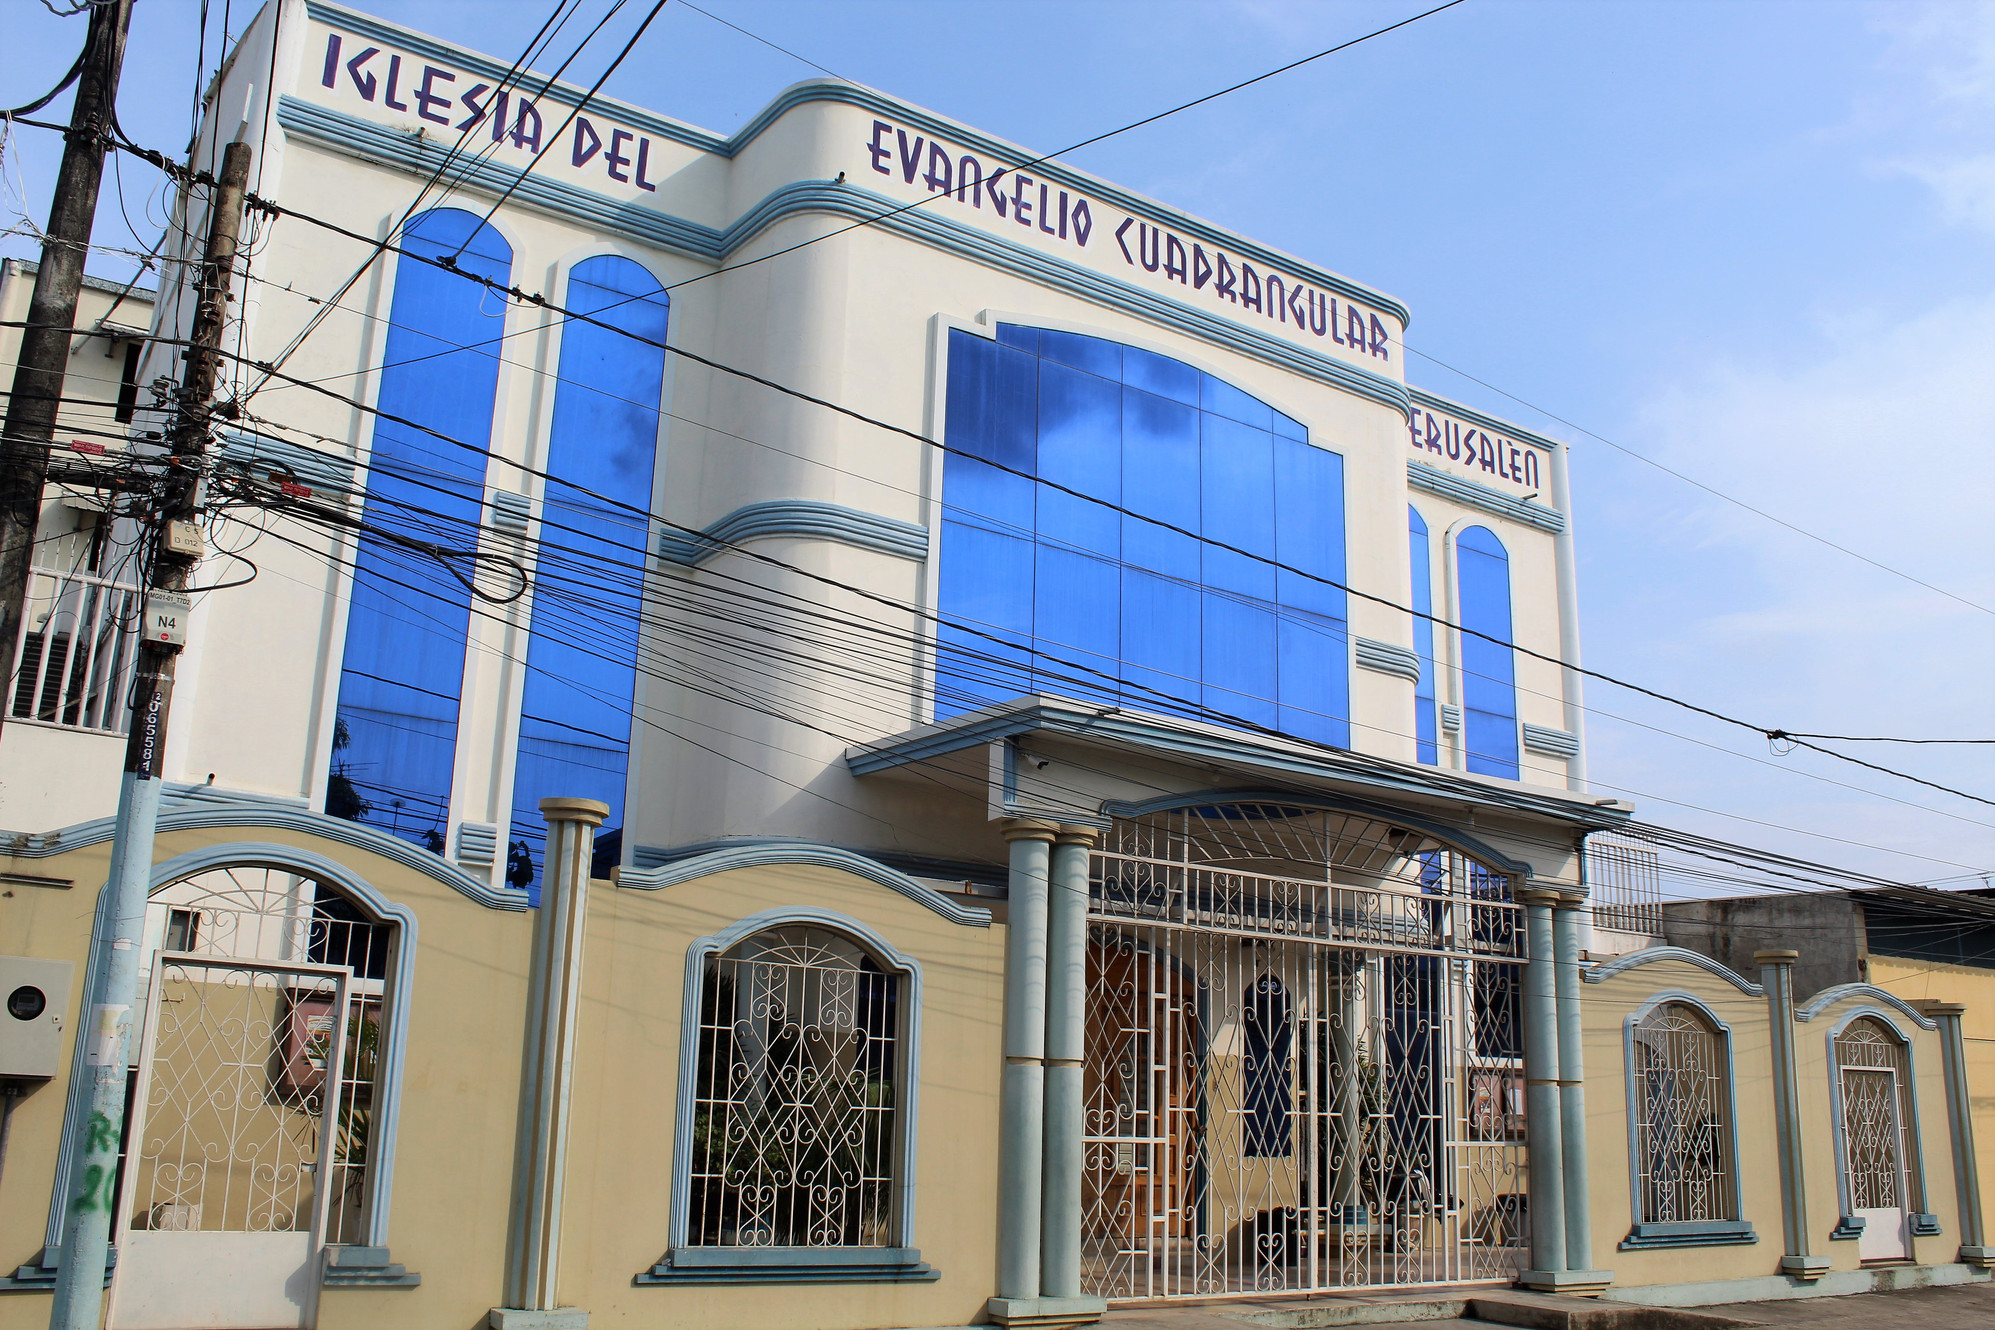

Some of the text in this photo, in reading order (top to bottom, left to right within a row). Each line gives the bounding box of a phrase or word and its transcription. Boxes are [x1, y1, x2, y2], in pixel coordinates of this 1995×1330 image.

[322, 34, 655, 192] IGLESIA DEL
[866, 120, 1388, 361] EVANGELIO CUADRANGULAR
[158, 615, 176, 629] N4
